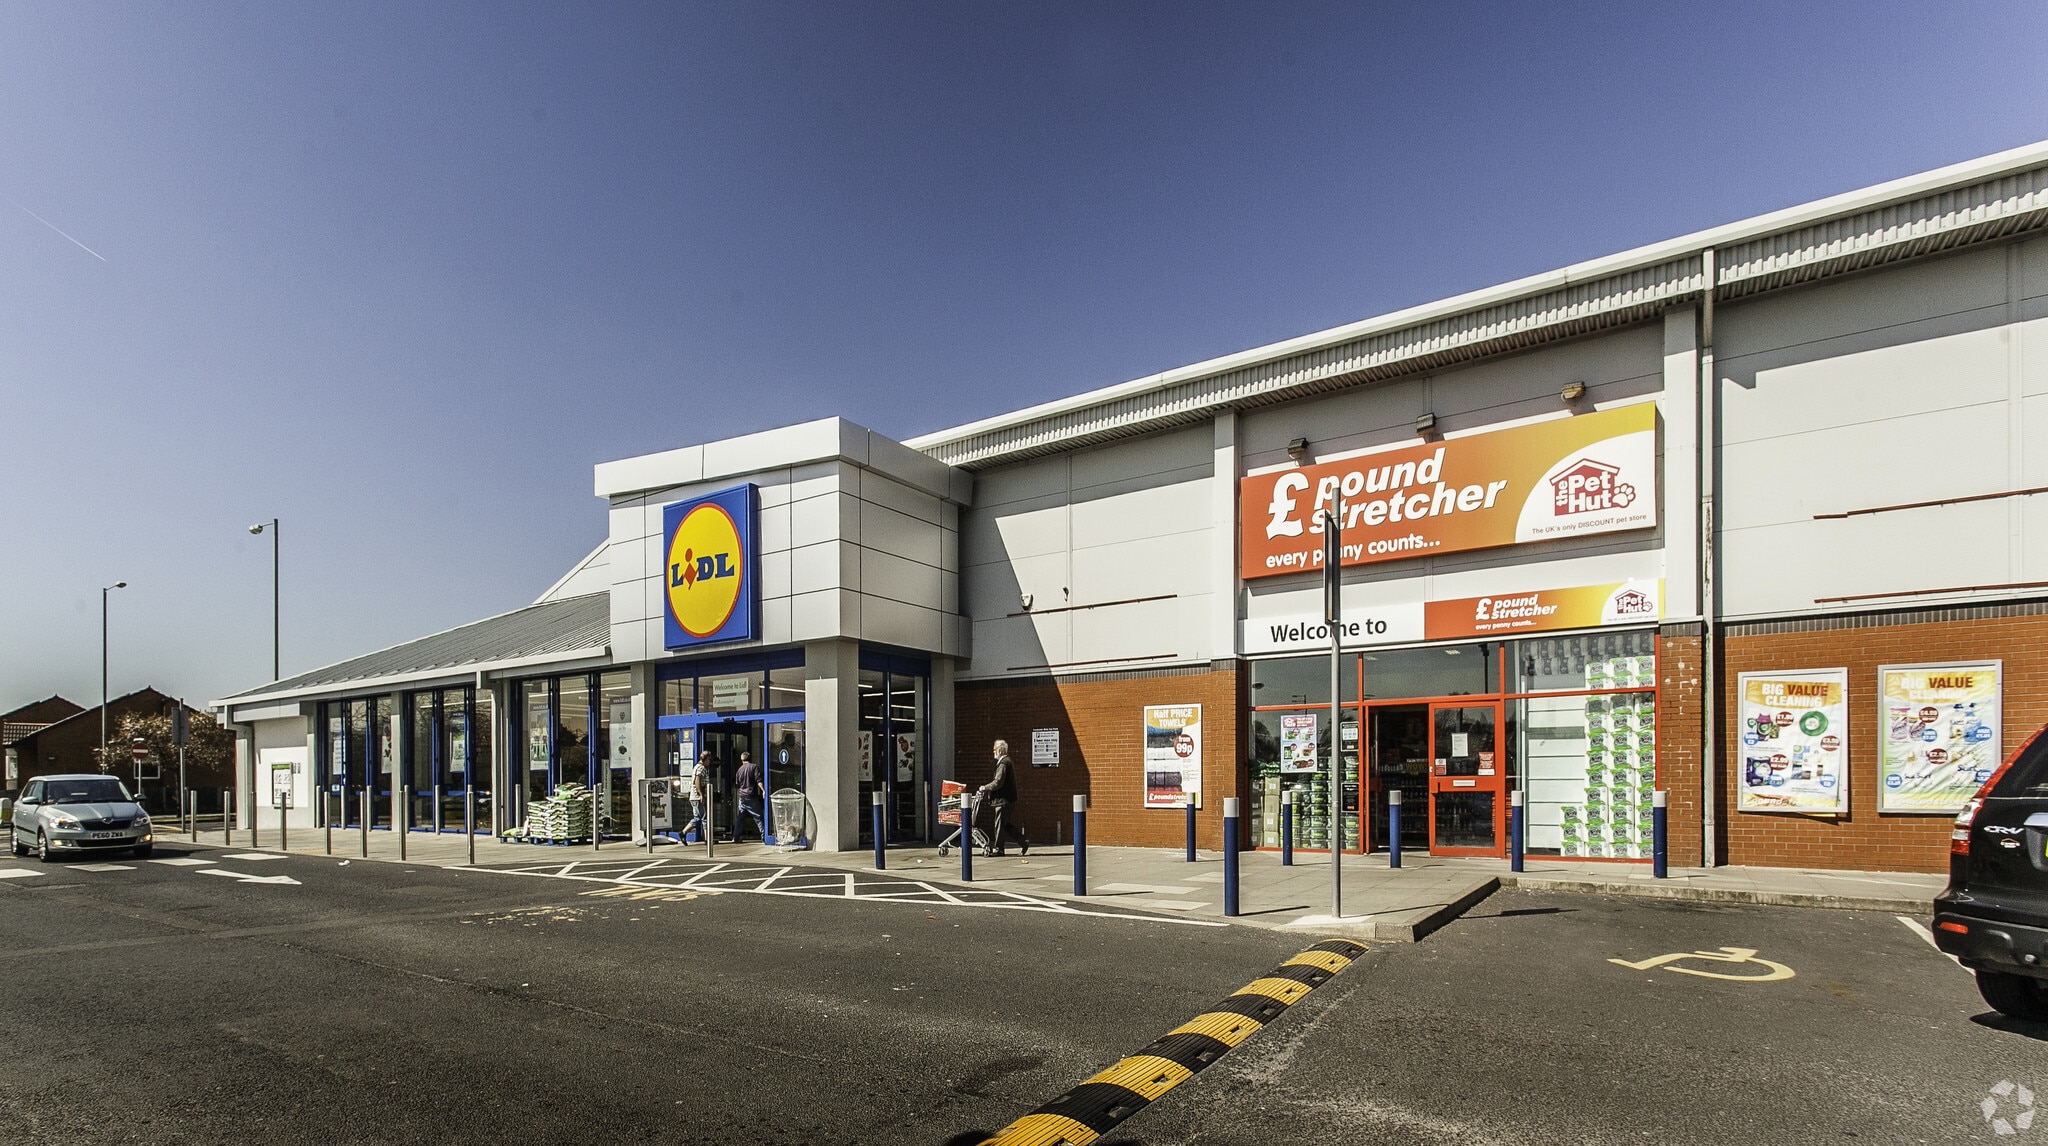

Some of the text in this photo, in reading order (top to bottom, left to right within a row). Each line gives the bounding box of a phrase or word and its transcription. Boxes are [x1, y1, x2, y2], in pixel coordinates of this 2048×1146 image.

[1314, 447, 1446, 511] pound
[1568, 471, 1611, 495] Pet
[1308, 480, 1508, 534] stretcher
[1568, 489, 1612, 513] Hut
[1578, 518, 1615, 529] DISCOUNT
[1616, 517, 1628, 525] pet
[1266, 551, 1308, 568] every
[1313, 543, 1363, 566] pny
[1493, 594, 1539, 612] pound
[1491, 604, 1558, 620] stretcher
[1366, 618, 1388, 635] to
[1492, 621, 1511, 630] penny
[1761, 684, 1829, 697] BIG VALUE
[1901, 676, 1974, 690] BIG VALUE
[1765, 695, 1824, 708] CLEANING
[1171, 708, 1193, 718] PRICE
[1159, 718, 1187, 728] TOWELS
[1176, 743, 1193, 755] 99p
